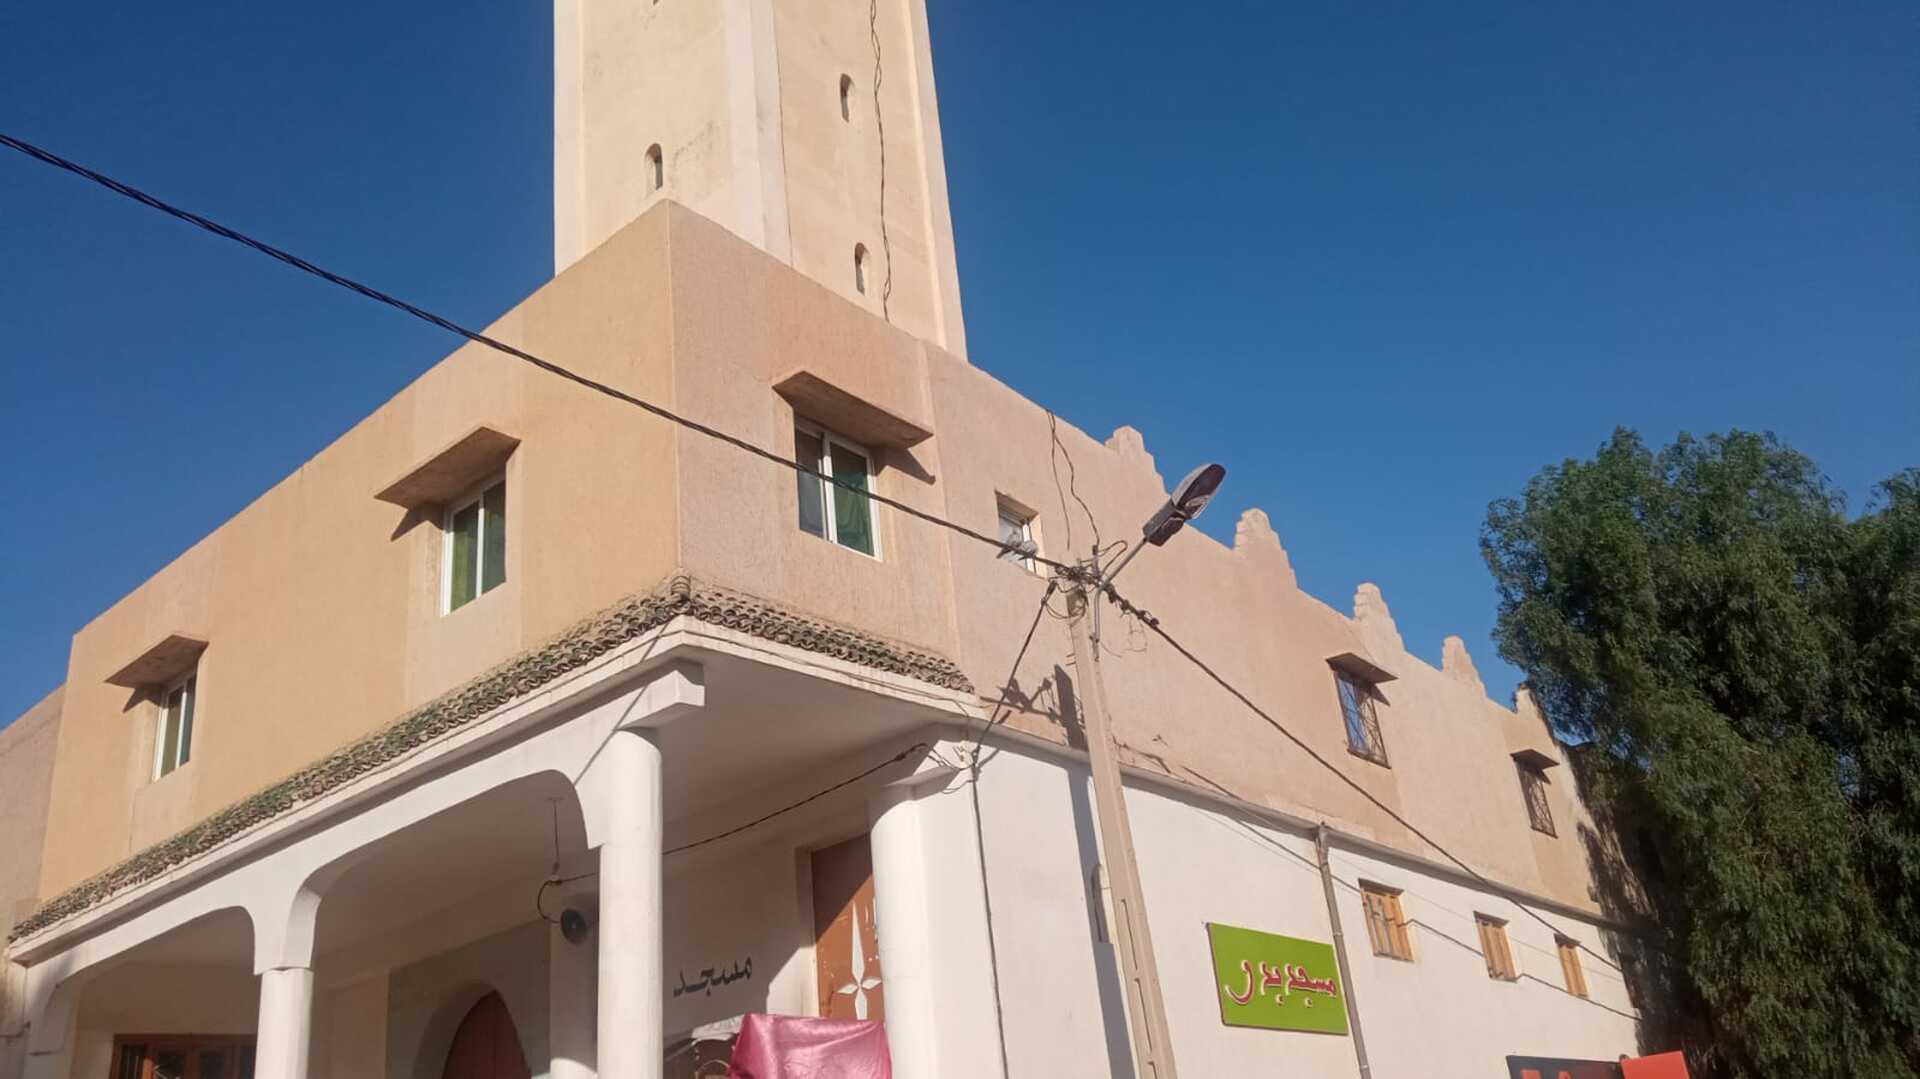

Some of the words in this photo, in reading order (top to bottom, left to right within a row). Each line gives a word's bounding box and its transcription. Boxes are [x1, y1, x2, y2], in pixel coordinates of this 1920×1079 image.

[673, 956, 752, 997] مسجد
[1225, 959, 1283, 1006] بدر
[1285, 962, 1336, 1008] مسجد
